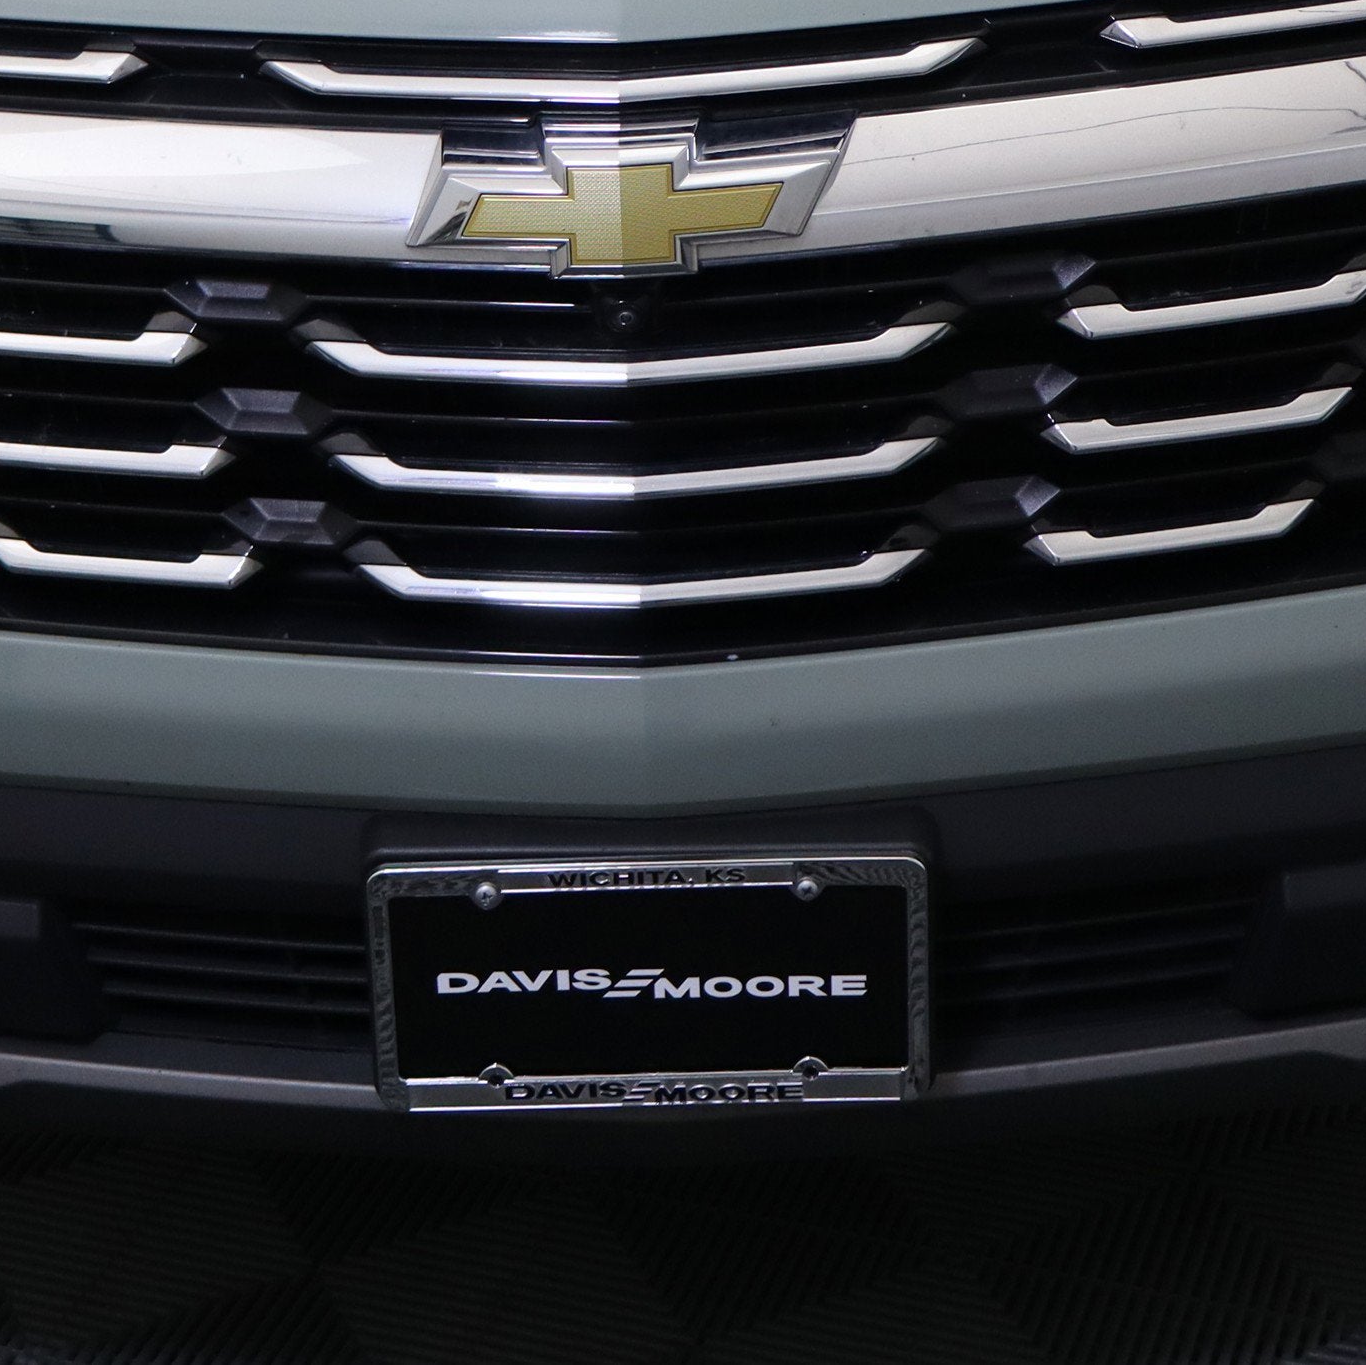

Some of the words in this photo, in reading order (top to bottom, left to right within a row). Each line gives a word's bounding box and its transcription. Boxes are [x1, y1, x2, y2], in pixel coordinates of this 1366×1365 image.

[704, 867, 747, 884] KS
[436, 968, 611, 995] DAVIS
[653, 974, 868, 999] MOORE
[504, 1079, 628, 1101] DAVIS
[654, 1081, 803, 1104] MOORE
